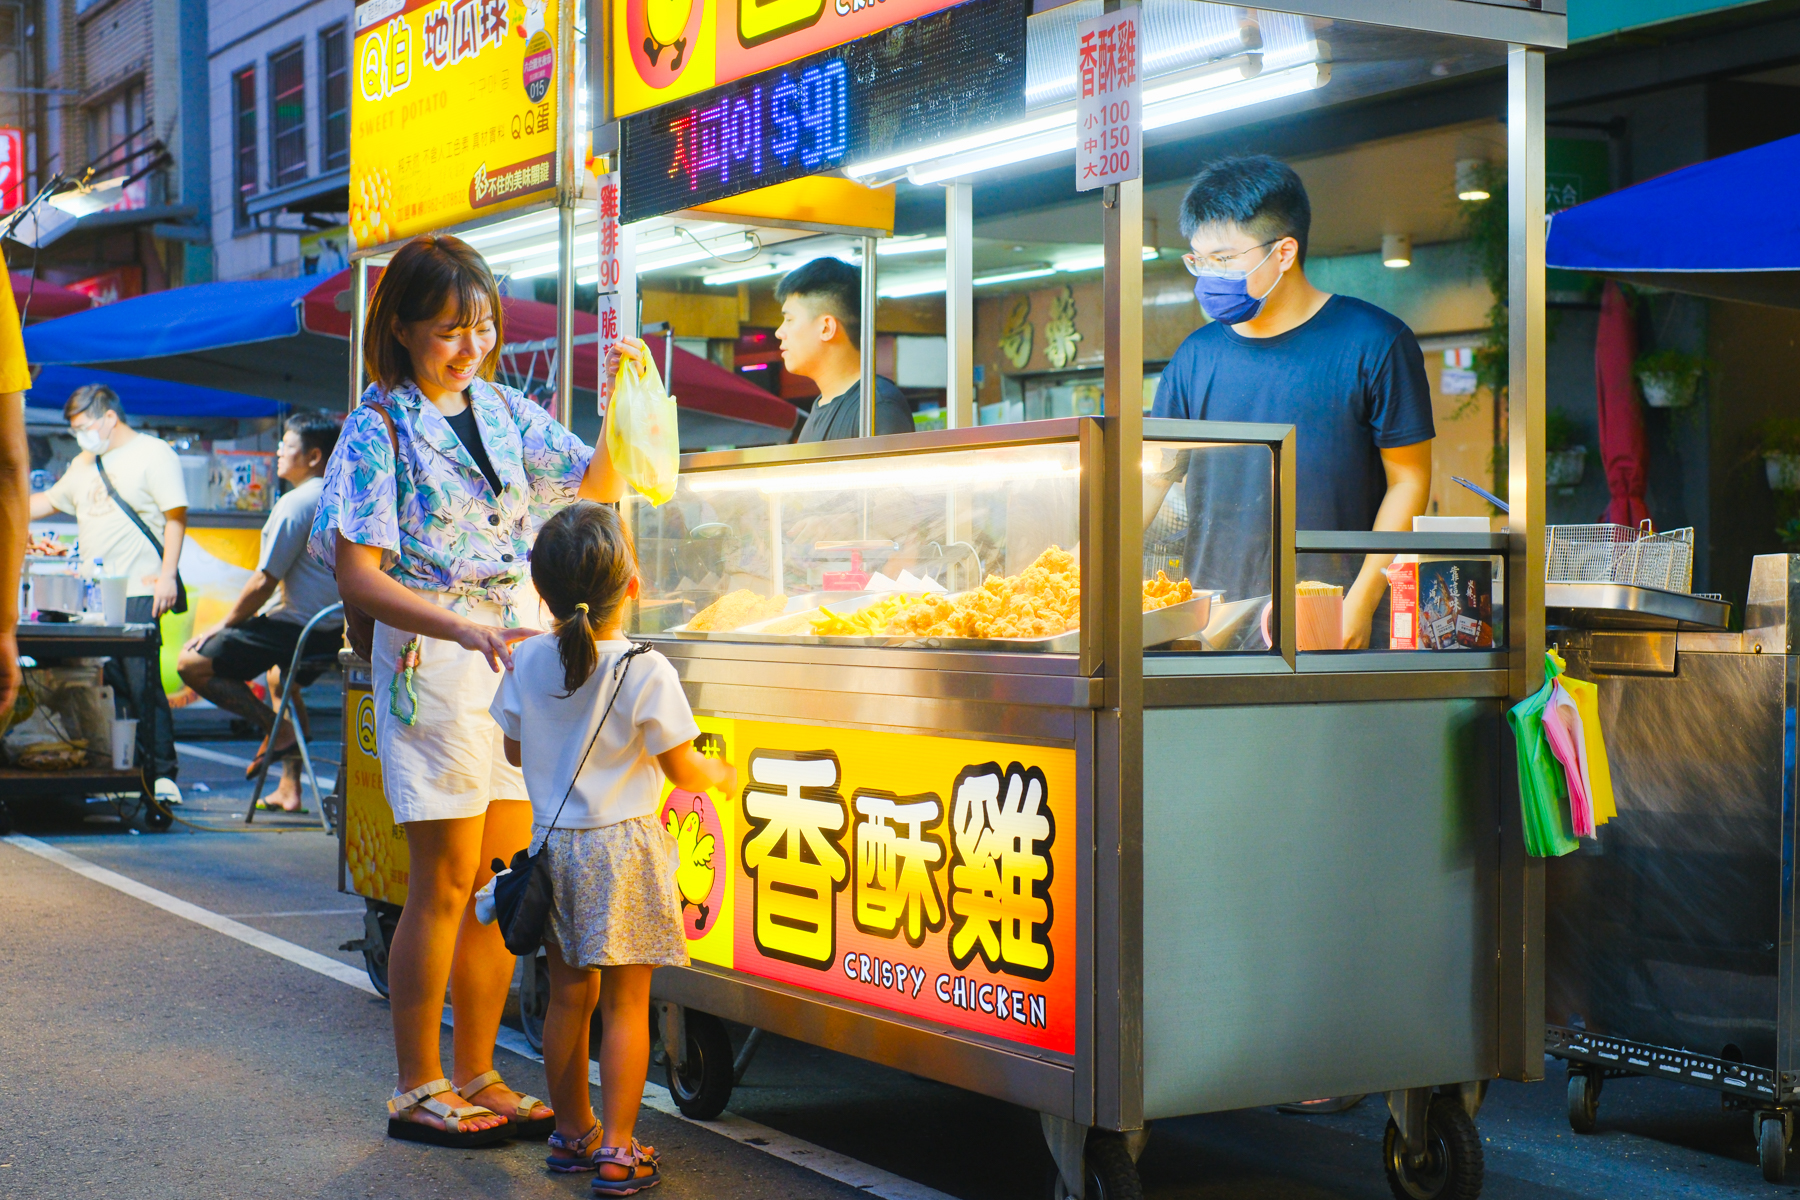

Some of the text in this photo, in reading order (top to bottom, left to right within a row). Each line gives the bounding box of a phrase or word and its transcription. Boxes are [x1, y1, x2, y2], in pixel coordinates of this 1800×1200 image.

[361, 0, 509, 100] Q伯 地瓜球
[529, 80, 545, 98] 015
[1079, 19, 1136, 99] 香酥雞
[358, 109, 395, 139] SWEET
[771, 58, 845, 166] $90
[743, 749, 1055, 980] 香酥雞
[843, 952, 1047, 1029] CRISPY CHICKEN
